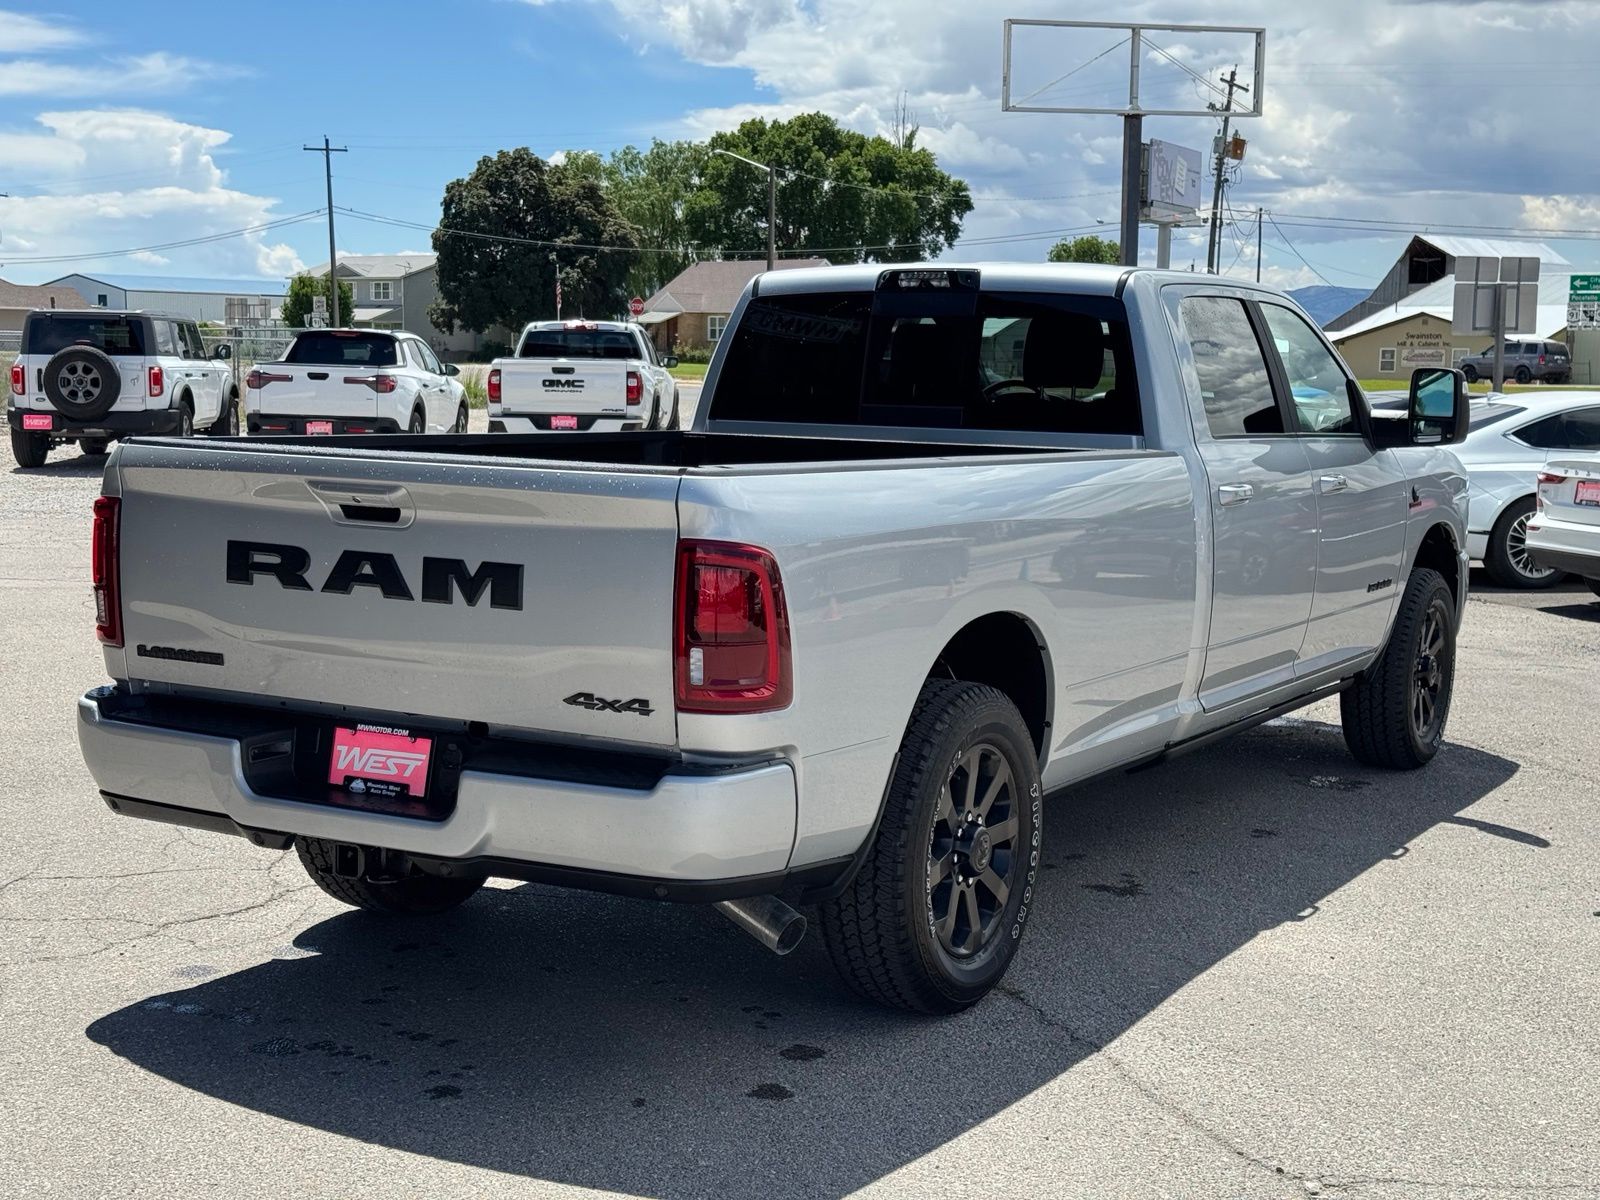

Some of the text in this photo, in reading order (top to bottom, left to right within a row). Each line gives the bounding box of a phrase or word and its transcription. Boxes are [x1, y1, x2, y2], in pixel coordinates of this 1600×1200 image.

[1569, 312, 1579, 320] 91
[1405, 331, 1443, 340] Swainston
[542, 379, 585, 388] GMC
[226, 539, 525, 612] RAM
[356, 723, 410, 736] MWMOTOR.COM
[336, 744, 427, 777] WEST
